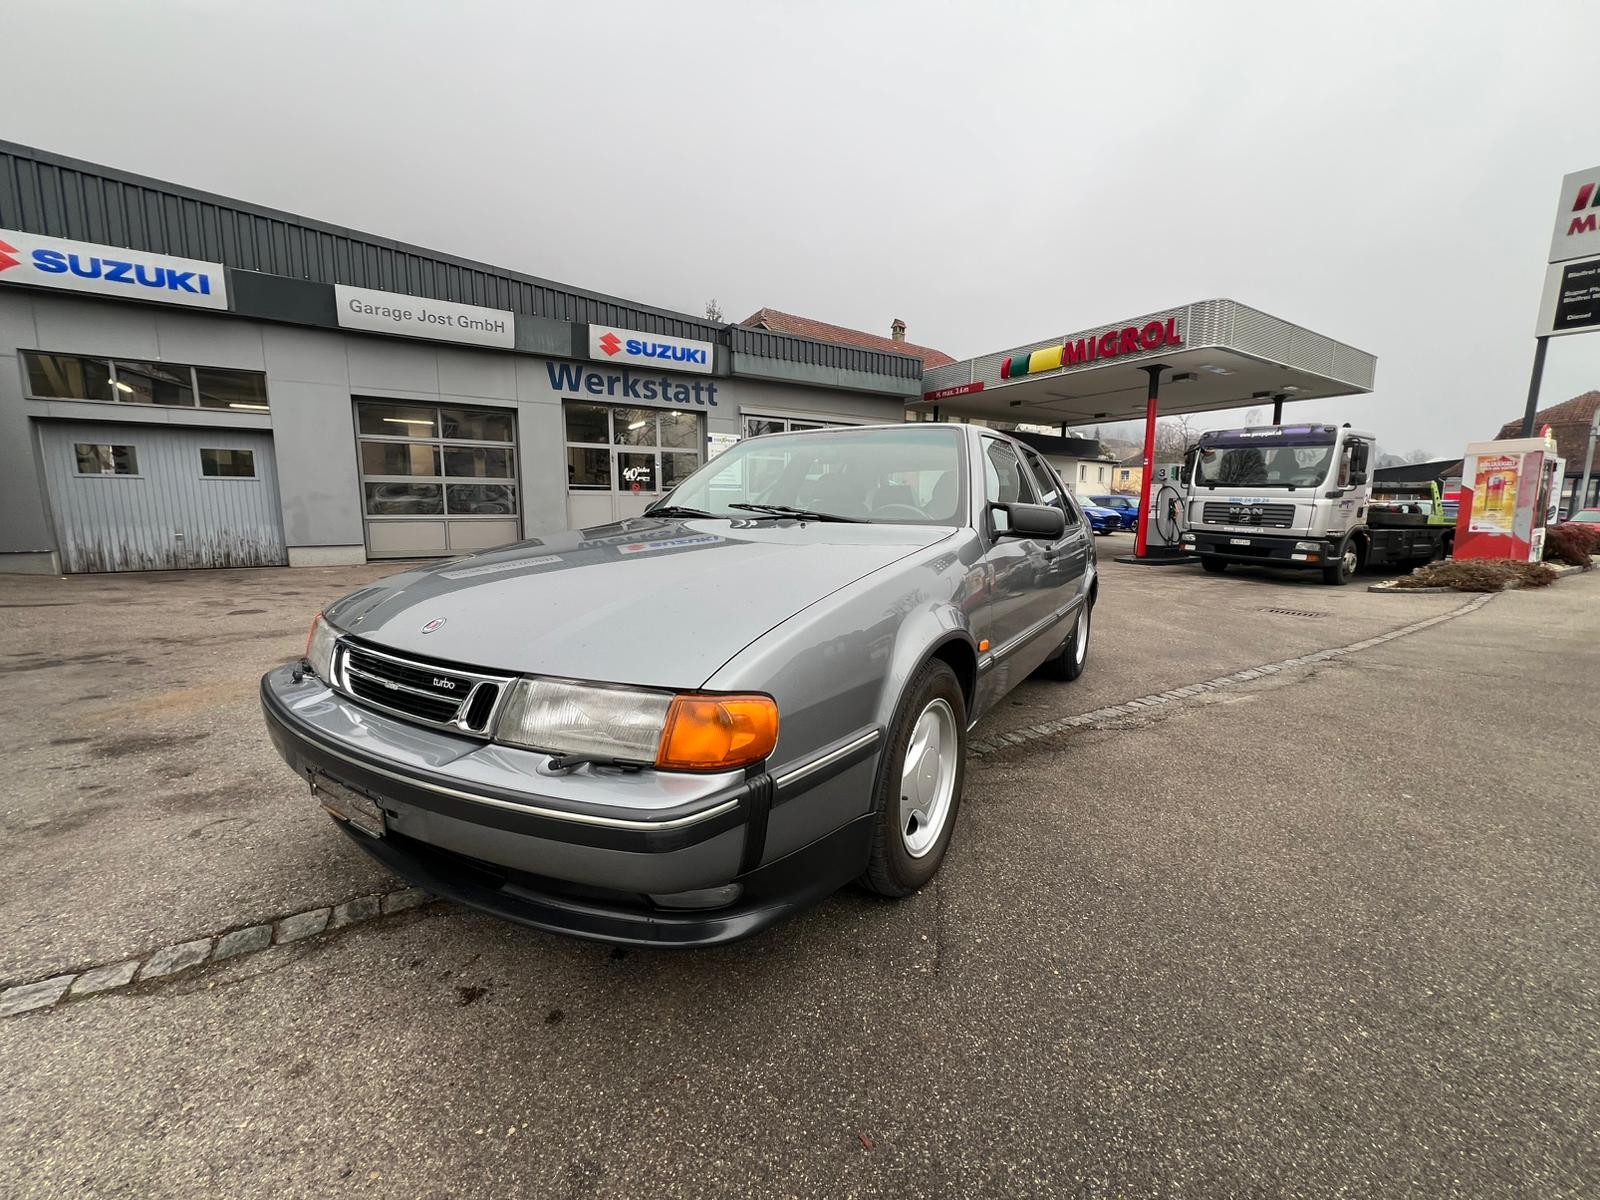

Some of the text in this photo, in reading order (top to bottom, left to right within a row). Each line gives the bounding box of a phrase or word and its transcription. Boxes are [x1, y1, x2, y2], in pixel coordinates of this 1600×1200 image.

[1567, 214, 1600, 236] M
[32, 249, 210, 295] SUZUKI
[349, 299, 505, 333] Garage Jost GmbH
[626, 339, 706, 364] SUZUKI
[1063, 317, 1182, 367] MIGROL
[546, 361, 718, 407] Werkstatt
[623, 467, 638, 480] 40
[1159, 468, 1166, 477] 3
[1230, 507, 1263, 515] MAN
[433, 677, 456, 690] turbo
